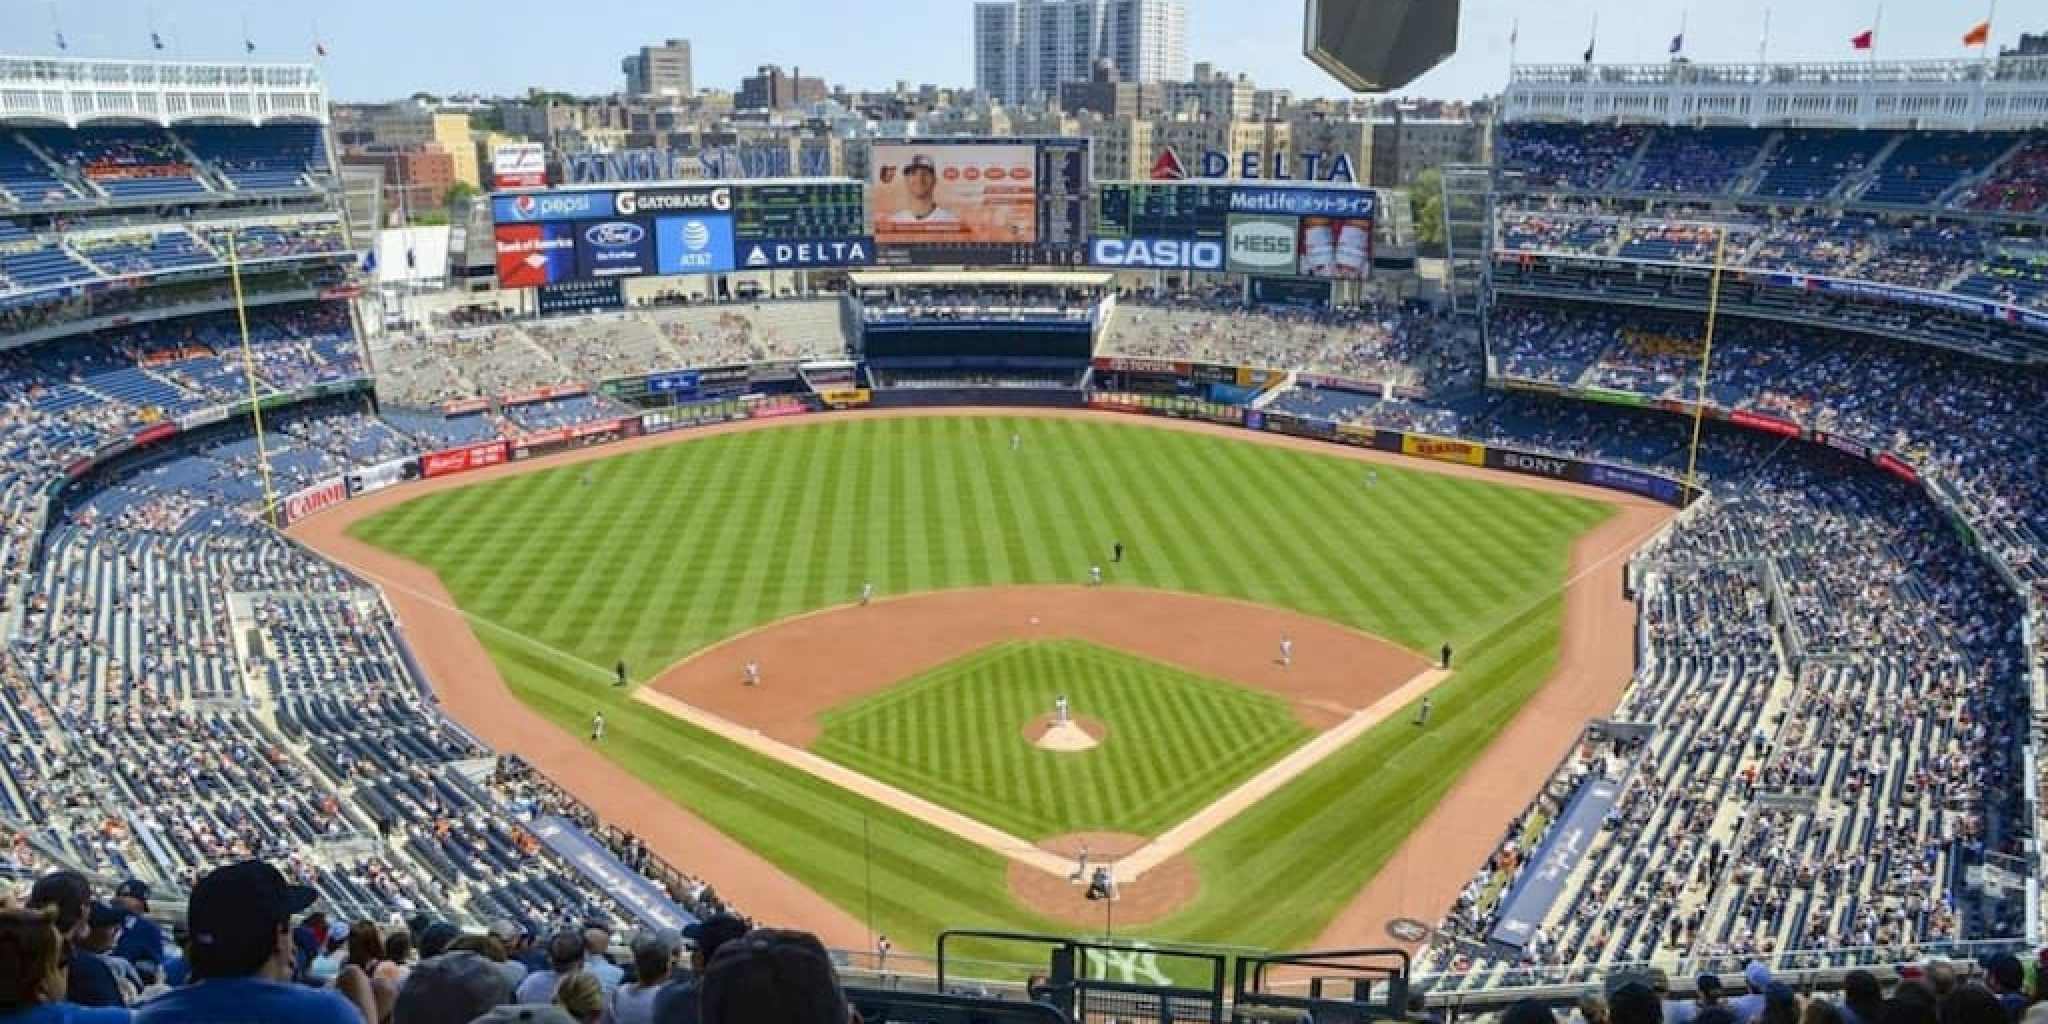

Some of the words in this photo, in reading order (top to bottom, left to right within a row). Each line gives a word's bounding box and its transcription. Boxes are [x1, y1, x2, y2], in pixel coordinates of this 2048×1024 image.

[1203, 151, 1356, 187] DELTA
[541, 195, 591, 214] pepsi
[637, 194, 709, 210] GATORADE
[1230, 192, 1296, 211] MetLife
[776, 243, 865, 262] DELTA
[1233, 234, 1291, 253] HESS
[1095, 239, 1223, 269] CASIO
[1503, 453, 1568, 475] SONY
[288, 482, 346, 521] Canon
